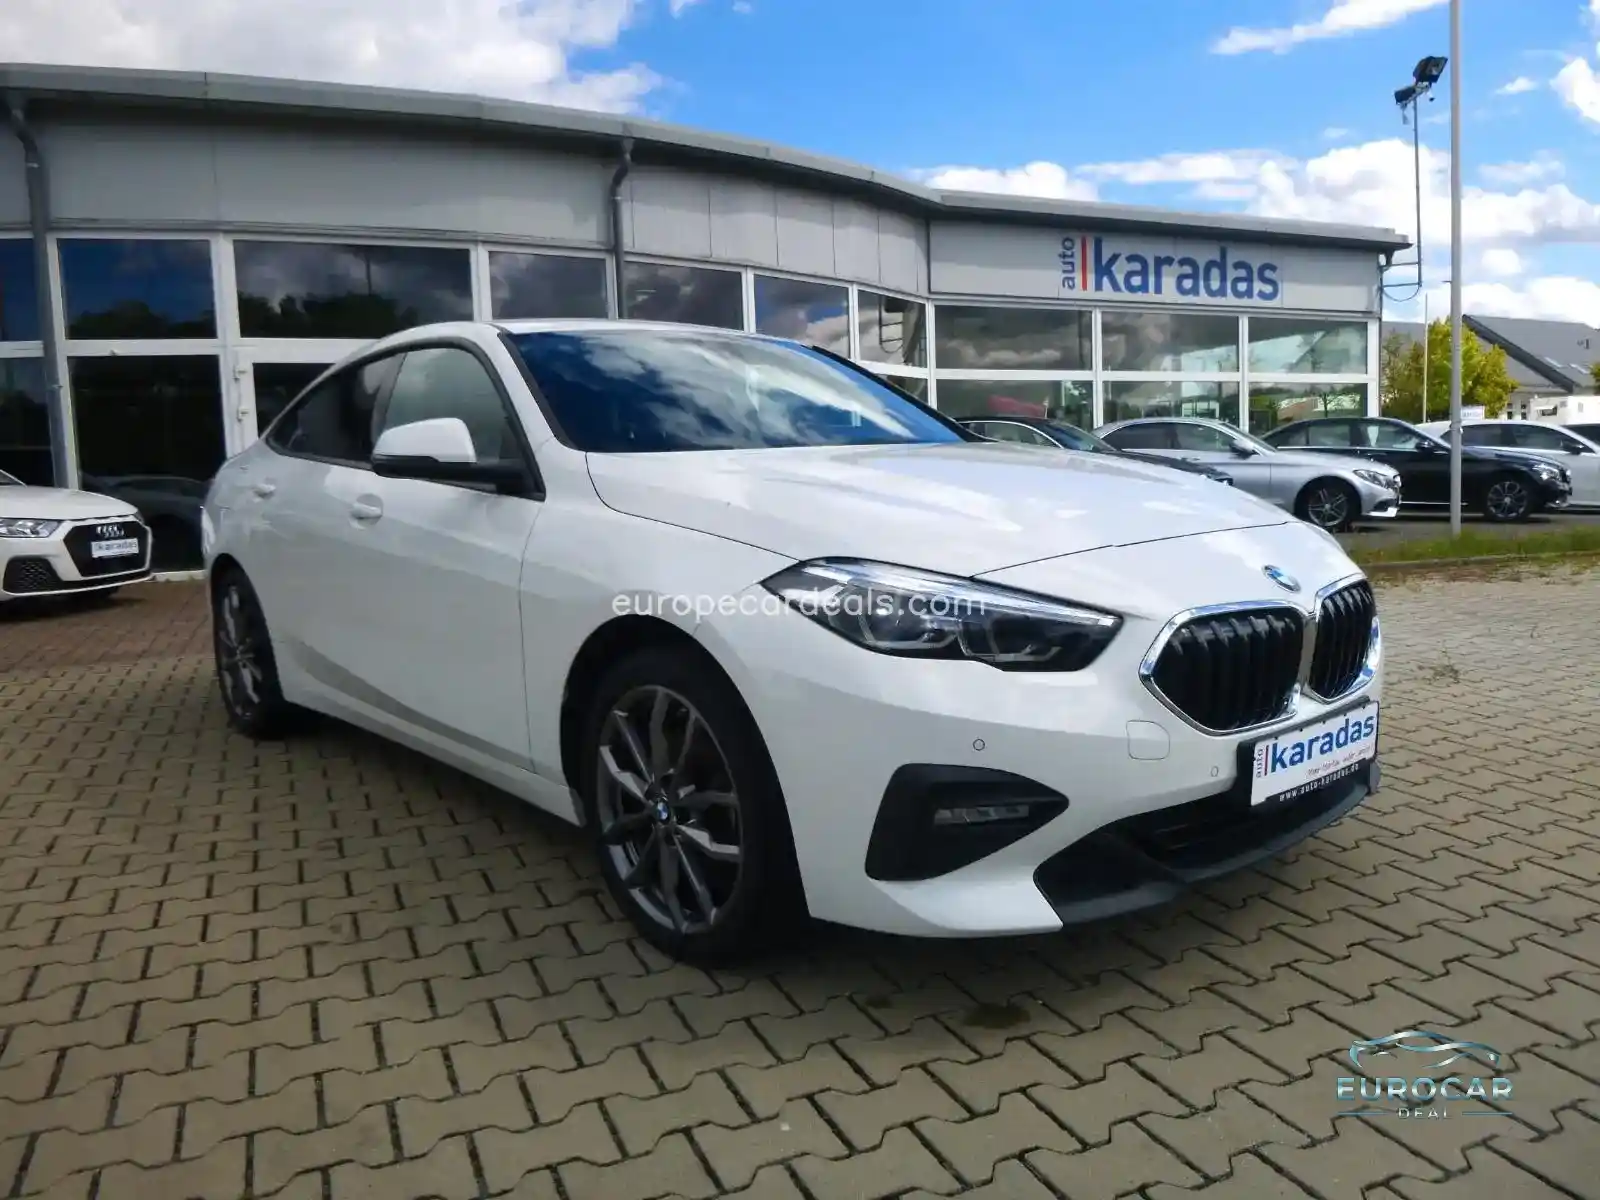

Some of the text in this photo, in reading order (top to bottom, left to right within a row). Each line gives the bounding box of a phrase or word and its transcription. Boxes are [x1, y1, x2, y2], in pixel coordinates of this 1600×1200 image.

[1058, 237, 1075, 290] auto
[1094, 237, 1279, 301] karadas
[1271, 715, 1375, 773] karadas
